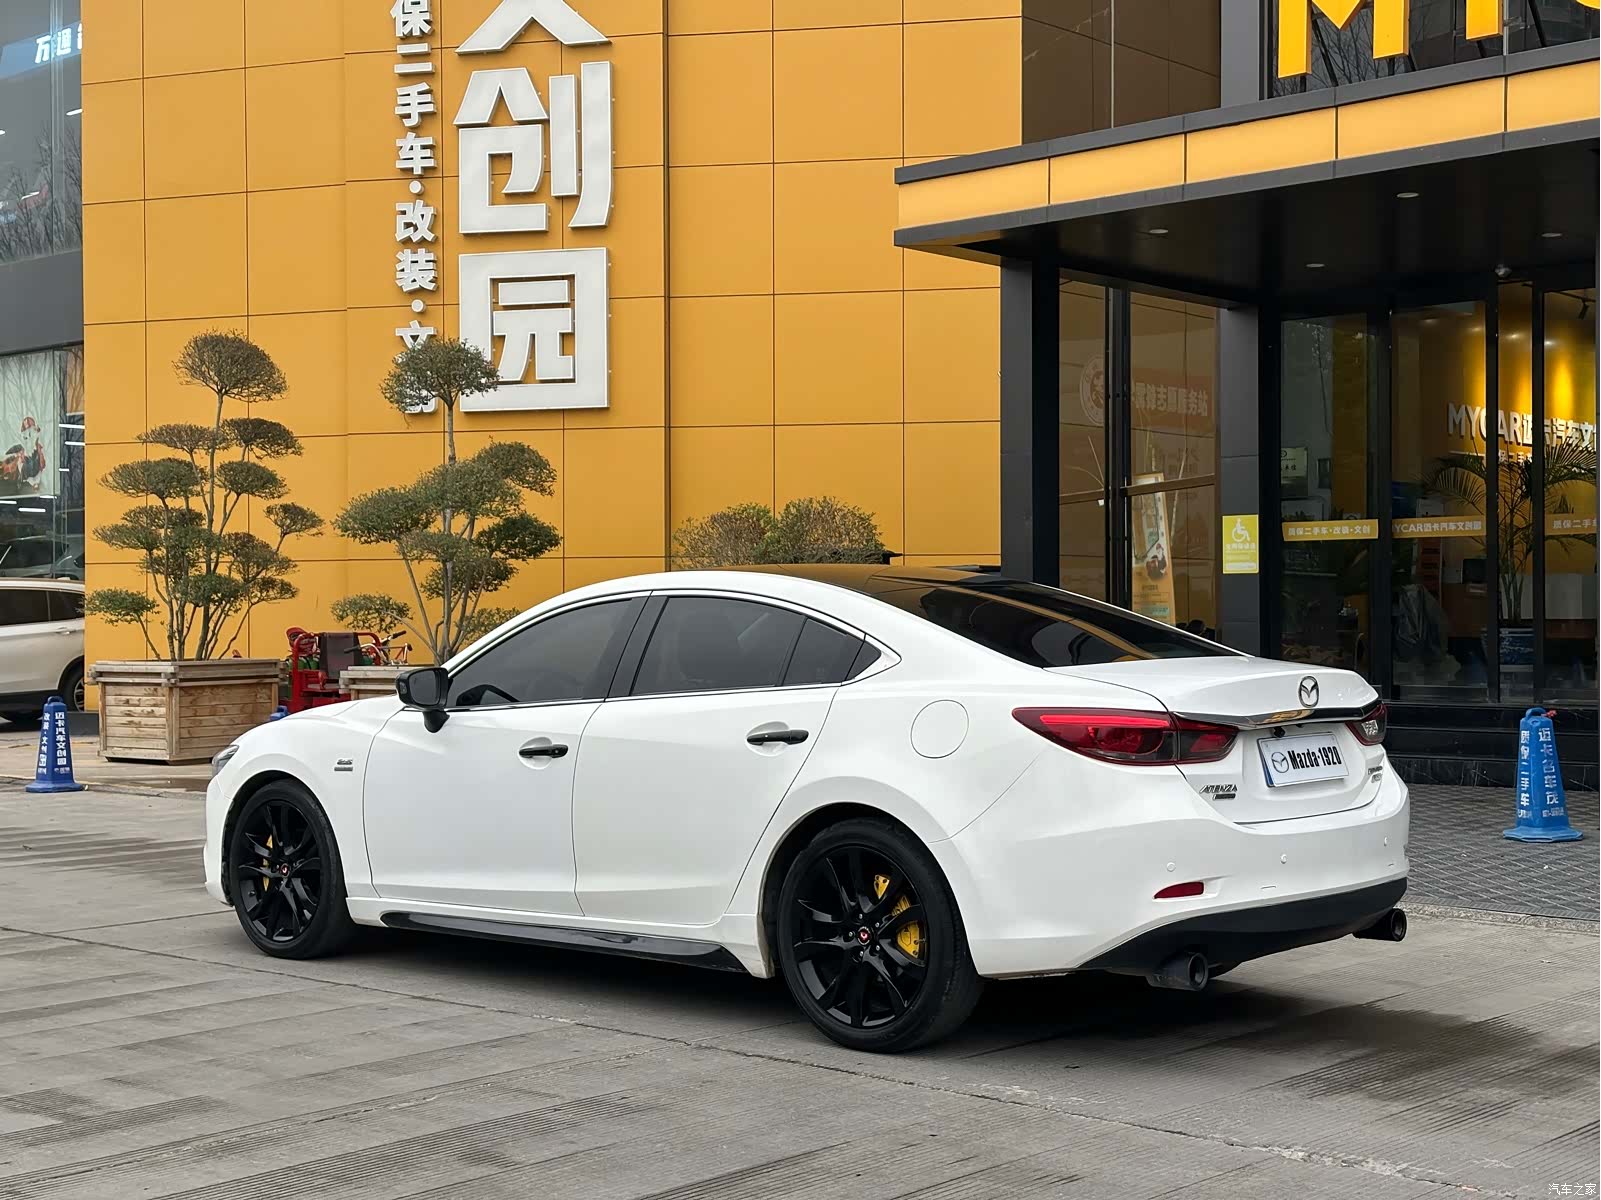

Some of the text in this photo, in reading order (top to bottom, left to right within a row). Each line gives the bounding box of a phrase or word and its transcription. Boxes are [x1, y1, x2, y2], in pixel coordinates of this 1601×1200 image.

[390, 0, 438, 413] 保二手车·改装·文
